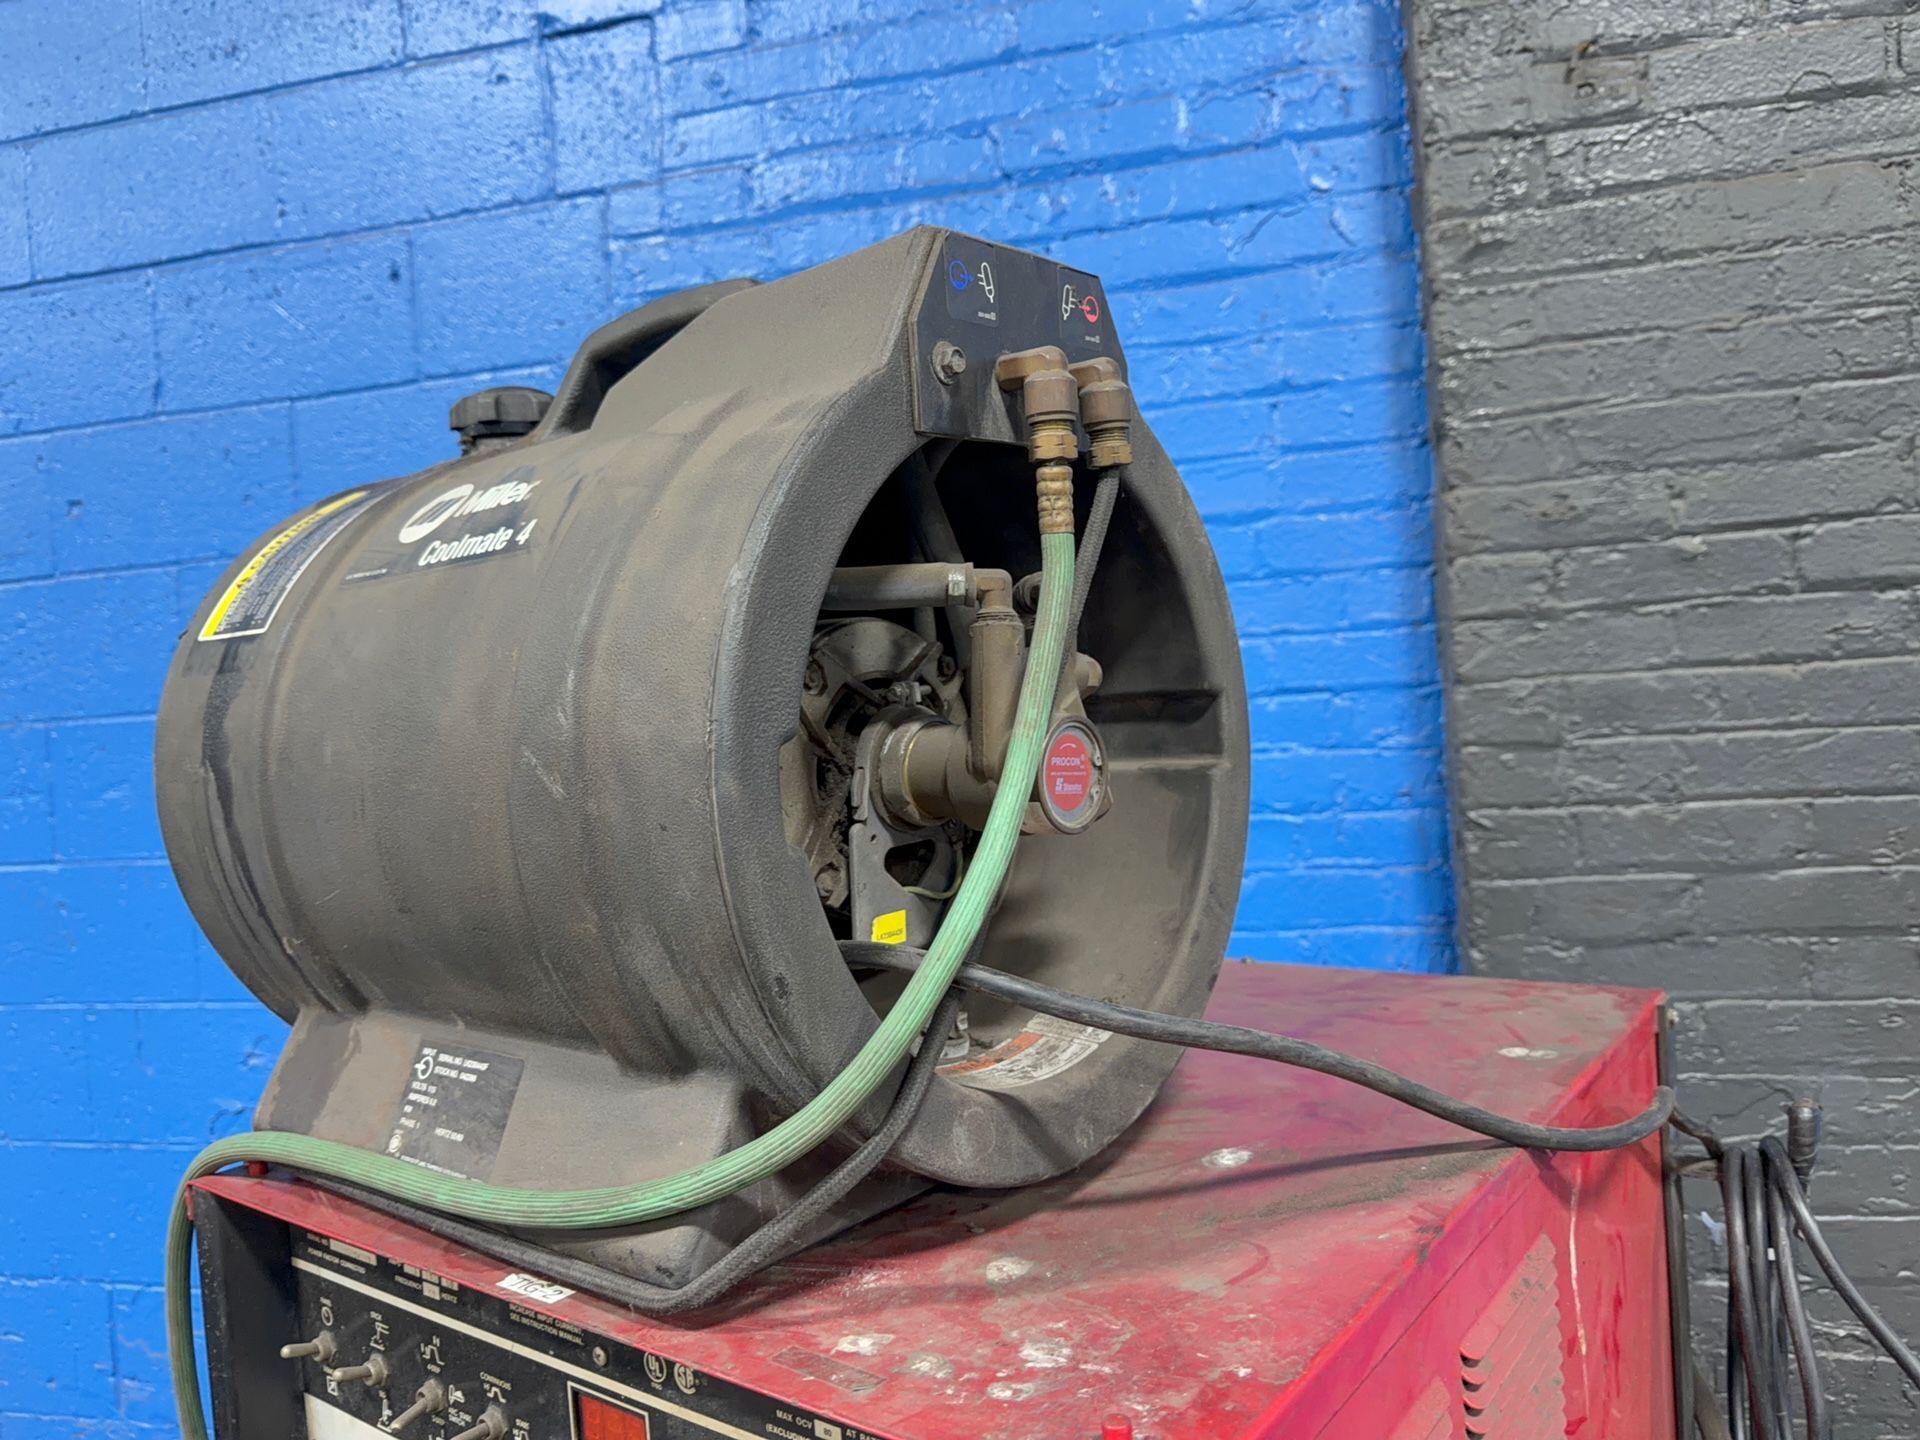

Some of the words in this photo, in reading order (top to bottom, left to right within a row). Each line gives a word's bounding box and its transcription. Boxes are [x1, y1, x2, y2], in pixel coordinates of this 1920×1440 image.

[418, 526, 514, 566] Coolmate
[515, 518, 538, 545] 4
[1051, 756, 1081, 767] PROCON
[775, 1409, 793, 1423] MAX
[795, 1417, 813, 1430] OCV
[846, 1429, 856, 1439] AT
